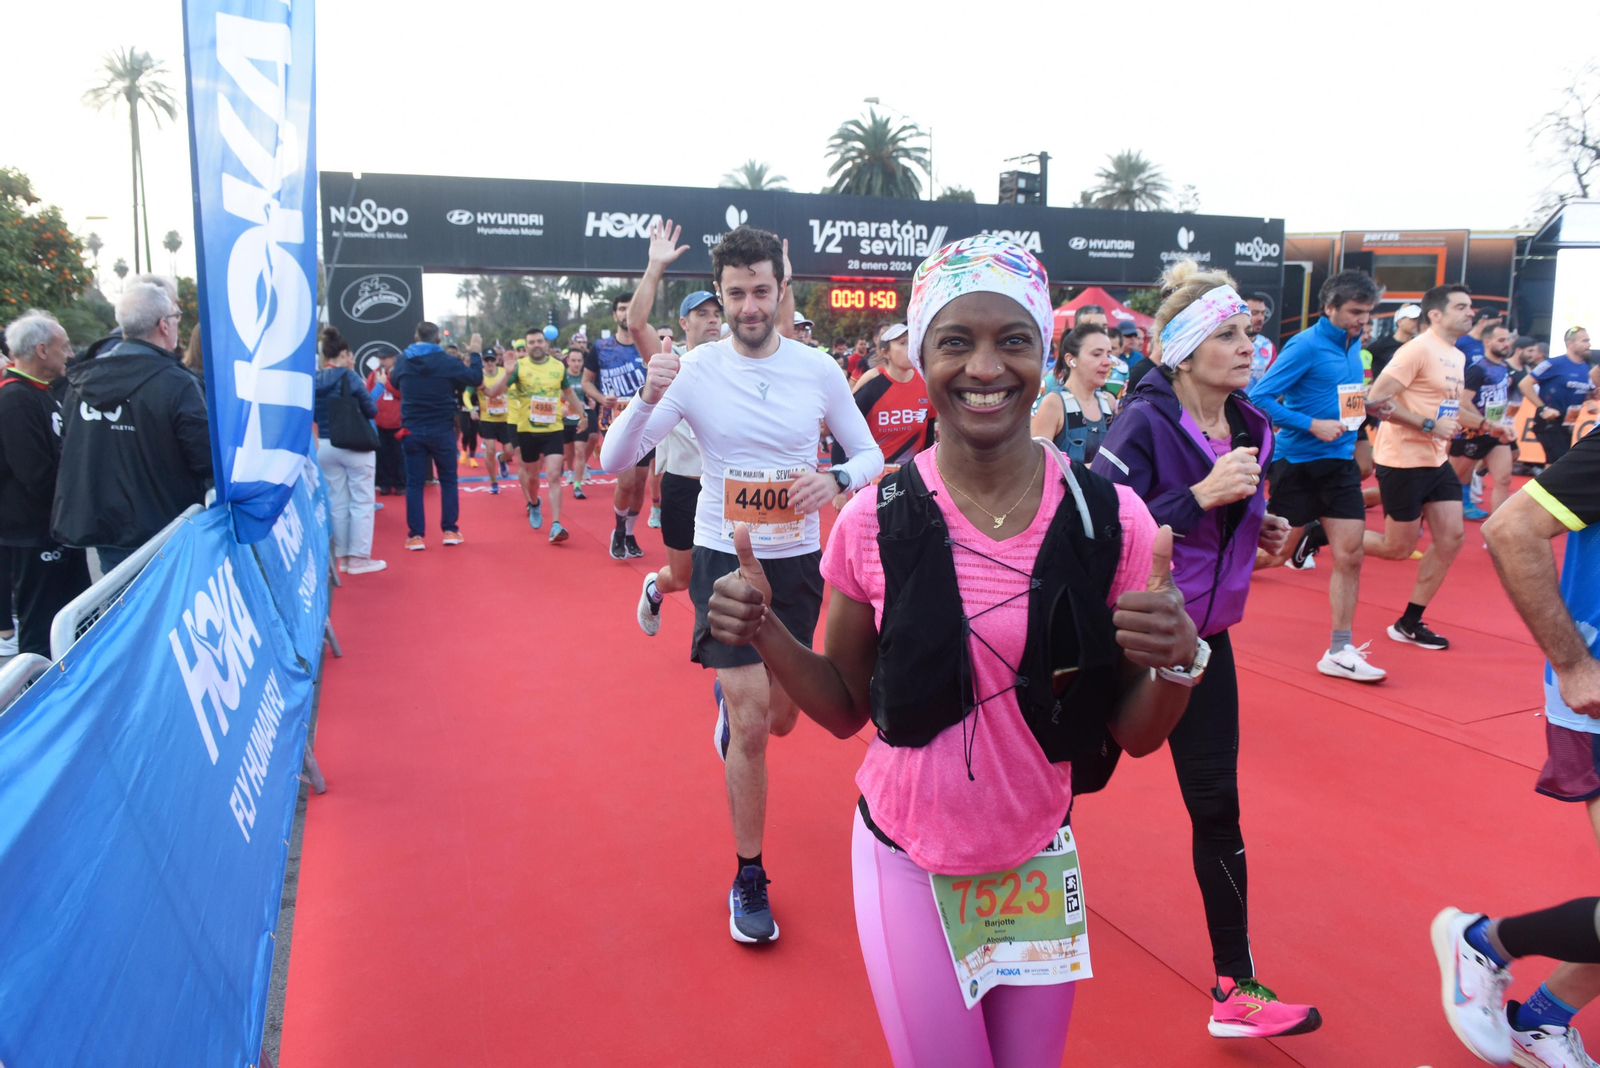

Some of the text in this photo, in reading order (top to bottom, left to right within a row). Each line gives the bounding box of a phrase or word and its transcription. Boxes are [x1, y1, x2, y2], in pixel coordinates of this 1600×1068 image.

[477, 212, 544, 226] HYUNDAI
[585, 211, 664, 238] HOKA
[477, 226, 544, 236] Hyundauto Motor
[836, 220, 928, 240] maratón
[216, 12, 313, 488] HOKA
[860, 238, 928, 257] sevilla
[1089, 239, 1134, 250] HYUNDAI
[848, 260, 912, 272] 28 enero 2024
[878, 409, 914, 426] B2B
[736, 488, 788, 510] 4400
[169, 556, 262, 766] HOKA
[229, 764, 255, 844] FLY
[242, 691, 279, 798] HUMAN
[952, 870, 1050, 925] 7523
[984, 918, 1015, 928] Barjotte
[996, 968, 1021, 976] HOKA
